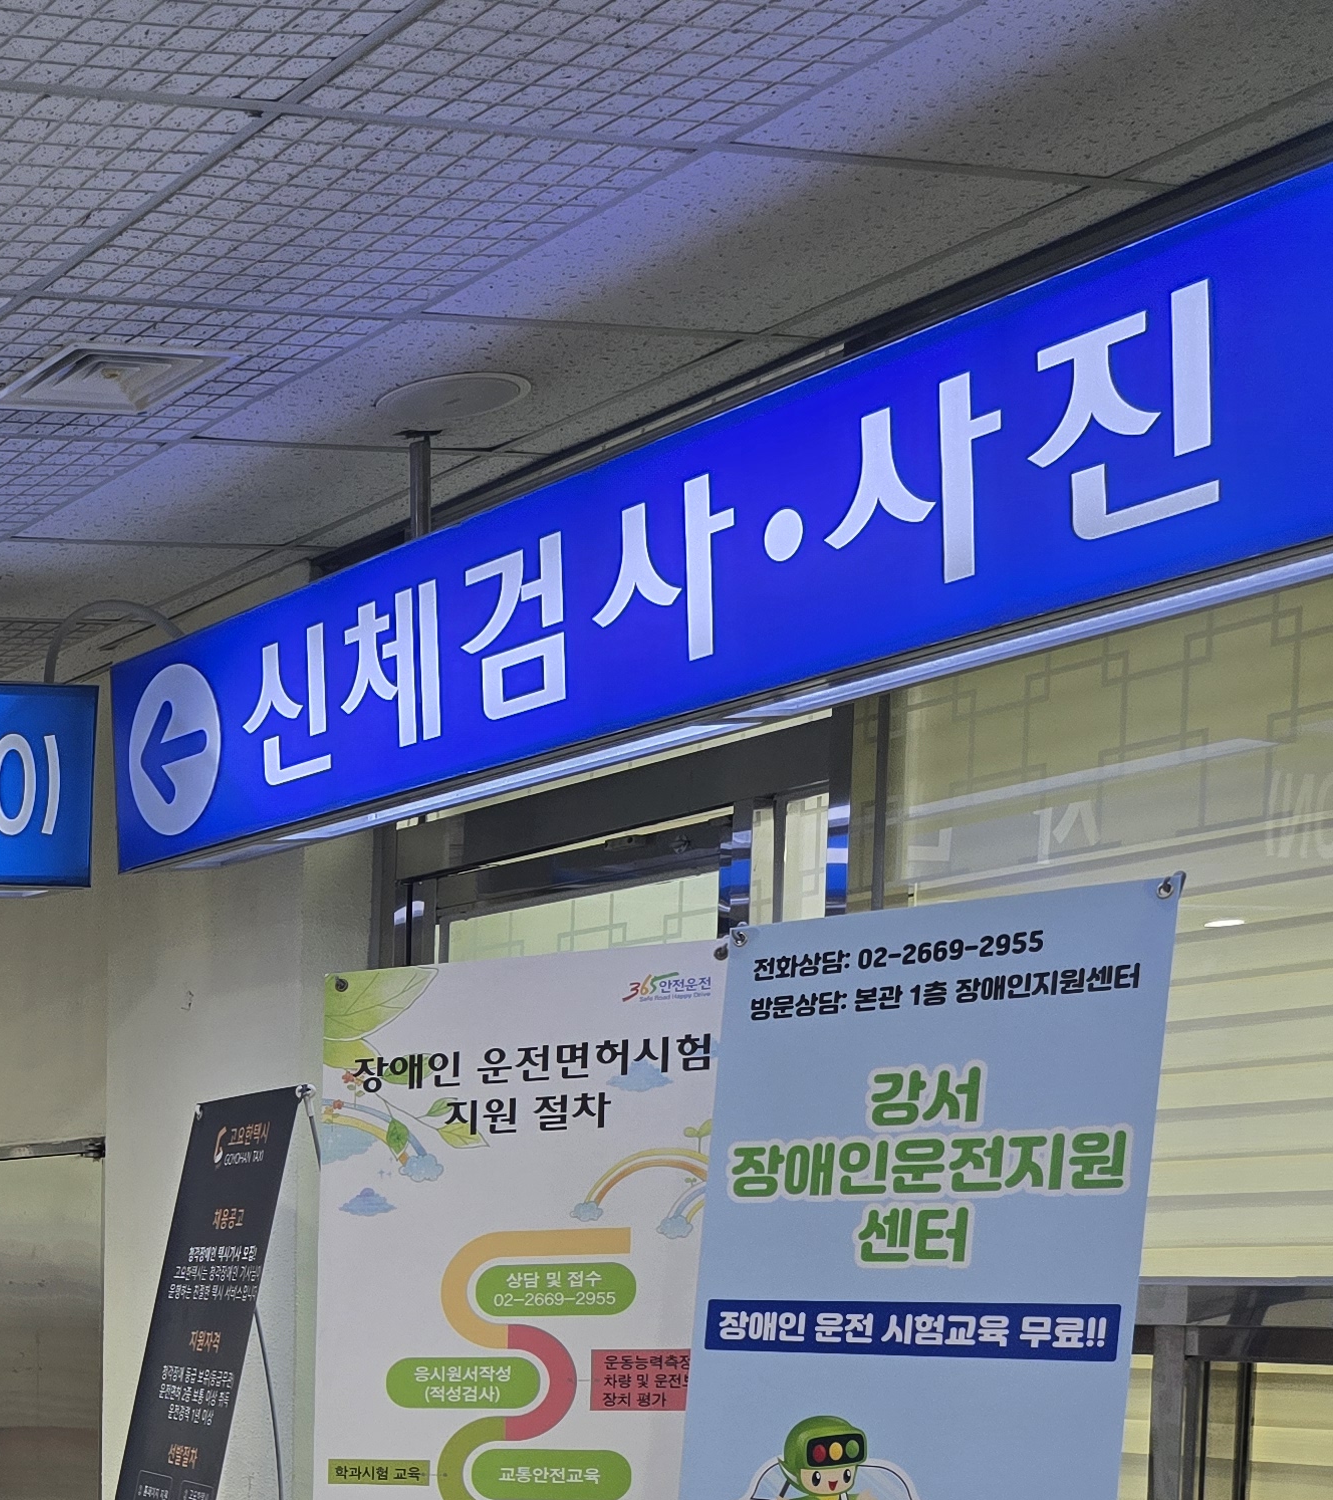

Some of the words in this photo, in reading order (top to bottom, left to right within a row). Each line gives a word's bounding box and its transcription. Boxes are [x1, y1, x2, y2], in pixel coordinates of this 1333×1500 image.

[242, 278, 1221, 785] 신체검사·사진
[754, 950, 851, 982] 전화상담:
[858, 930, 1045, 969] 02-2669-2955
[750, 991, 847, 1021] 방문상담:
[855, 984, 903, 1013] 본관
[911, 982, 947, 1007] 1층
[955, 962, 1141, 1005] 장애인지원센터
[353, 1050, 460, 1094] 장애인
[477, 1032, 712, 1085] 운전면허시험
[870, 1066, 982, 1127] 강서
[445, 1097, 516, 1136] 지원
[533, 1091, 612, 1131] 절차
[228, 1122, 269, 1146] 고요한택시
[731, 1129, 1127, 1199] 장애인운전지원
[212, 1208, 244, 1229] 채용공고
[857, 1205, 969, 1263] 센터
[505, 1272, 541, 1289] 상담
[545, 1271, 562, 1288] 및
[566, 1270, 602, 1287] 접수
[493, 1290, 616, 1308] 02-2669-2955
[188, 1330, 220, 1352] 지원자격
[719, 1310, 806, 1343] 장애인
[814, 1313, 874, 1344] 운전
[881, 1314, 1010, 1348] 시험교육
[1019, 1317, 1107, 1349] 무료!!
[413, 1365, 512, 1384] 응시원서작성
[603, 1372, 632, 1389] 차량
[636, 1372, 649, 1389] 및
[424, 1384, 501, 1404] (적성검사)
[602, 1391, 632, 1408] 장치
[637, 1391, 667, 1408] 평가
[334, 1465, 389, 1481] 학과시험
[393, 1465, 422, 1482] 교육
[497, 1465, 601, 1485] 교통안전교육
